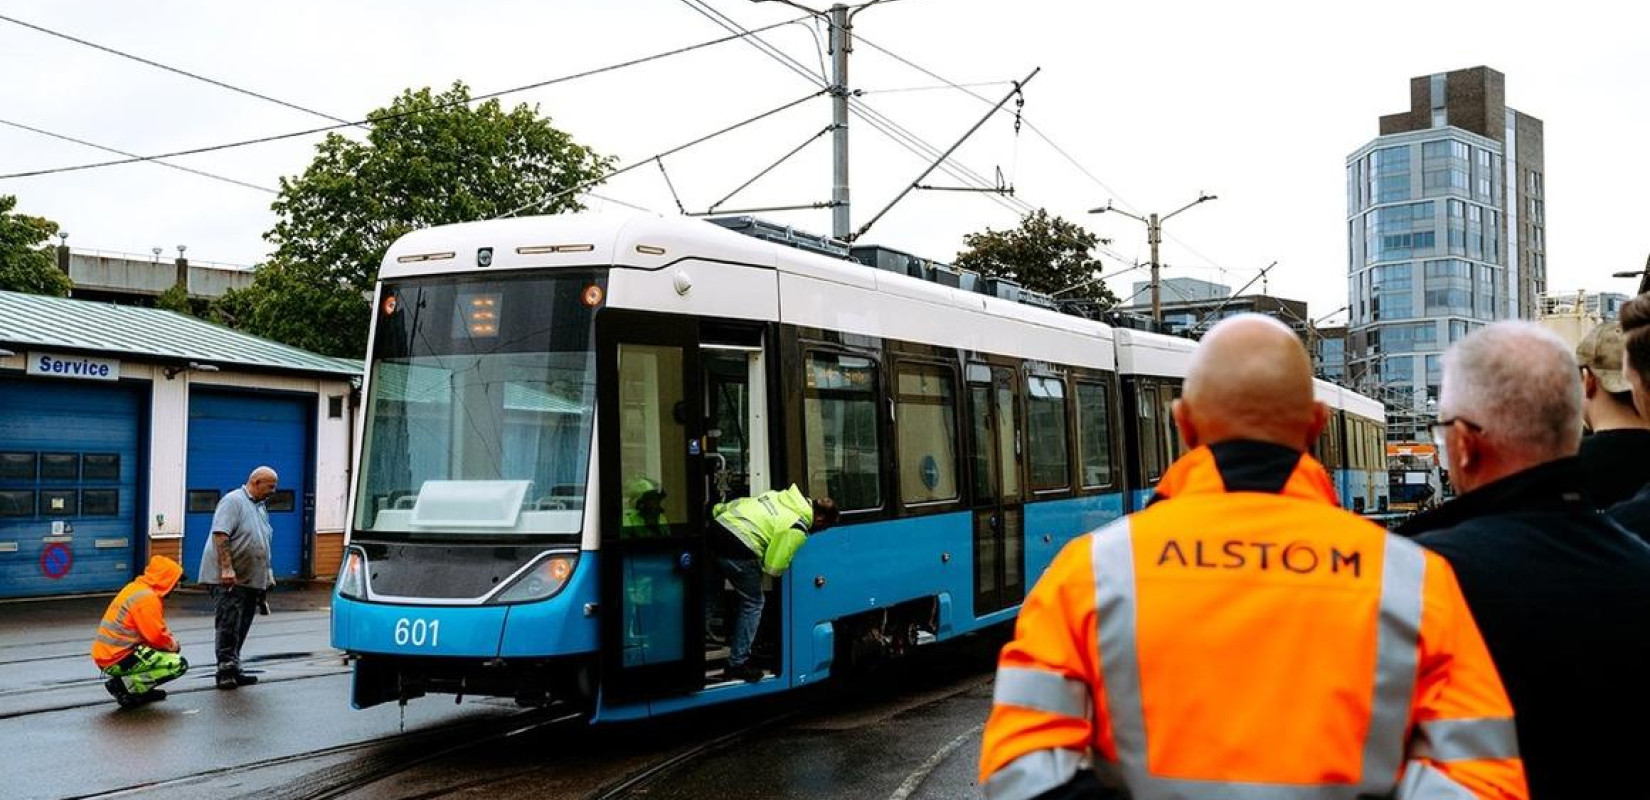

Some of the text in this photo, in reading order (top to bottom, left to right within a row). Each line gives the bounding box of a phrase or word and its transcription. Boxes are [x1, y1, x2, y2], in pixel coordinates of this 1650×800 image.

[39, 355, 109, 376] Service
[1157, 540, 1361, 577] ALSTOM
[394, 617, 439, 647] 601
